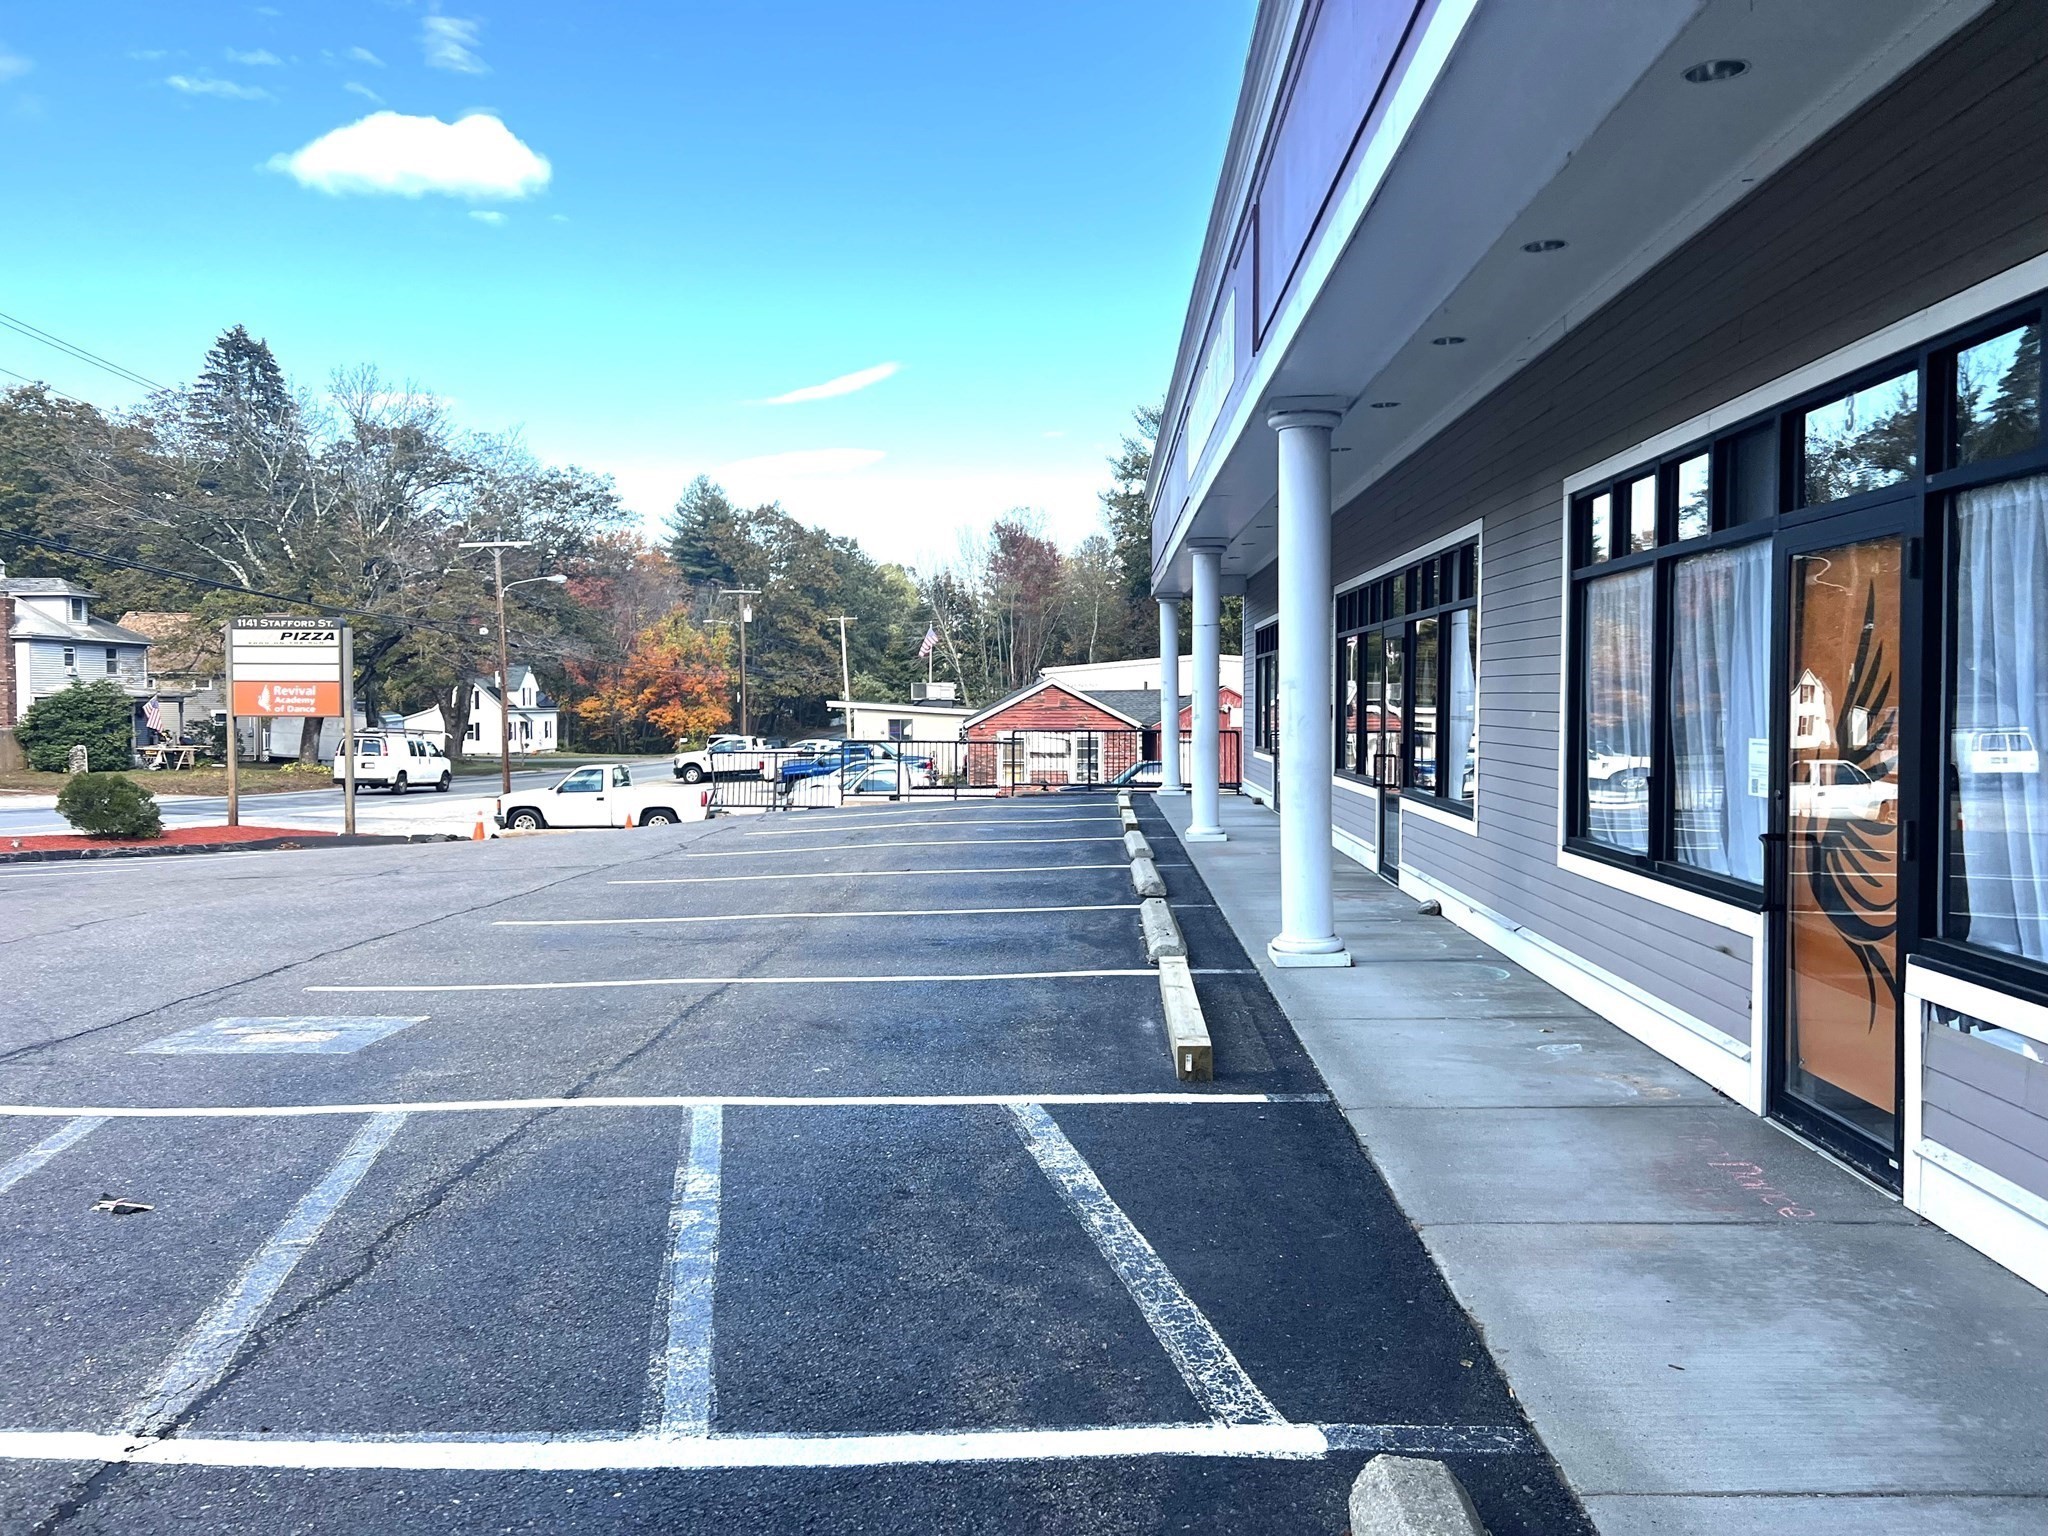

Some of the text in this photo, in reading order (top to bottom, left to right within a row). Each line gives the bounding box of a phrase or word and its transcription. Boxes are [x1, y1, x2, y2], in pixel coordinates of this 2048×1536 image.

[237, 619, 257, 627] 1141
[260, 619, 315, 627] STAFFORD
[280, 632, 335, 641] PIZZA
[273, 685, 316, 695] Revival
[275, 697, 316, 705] Academy
[274, 705, 316, 713] of Dance
